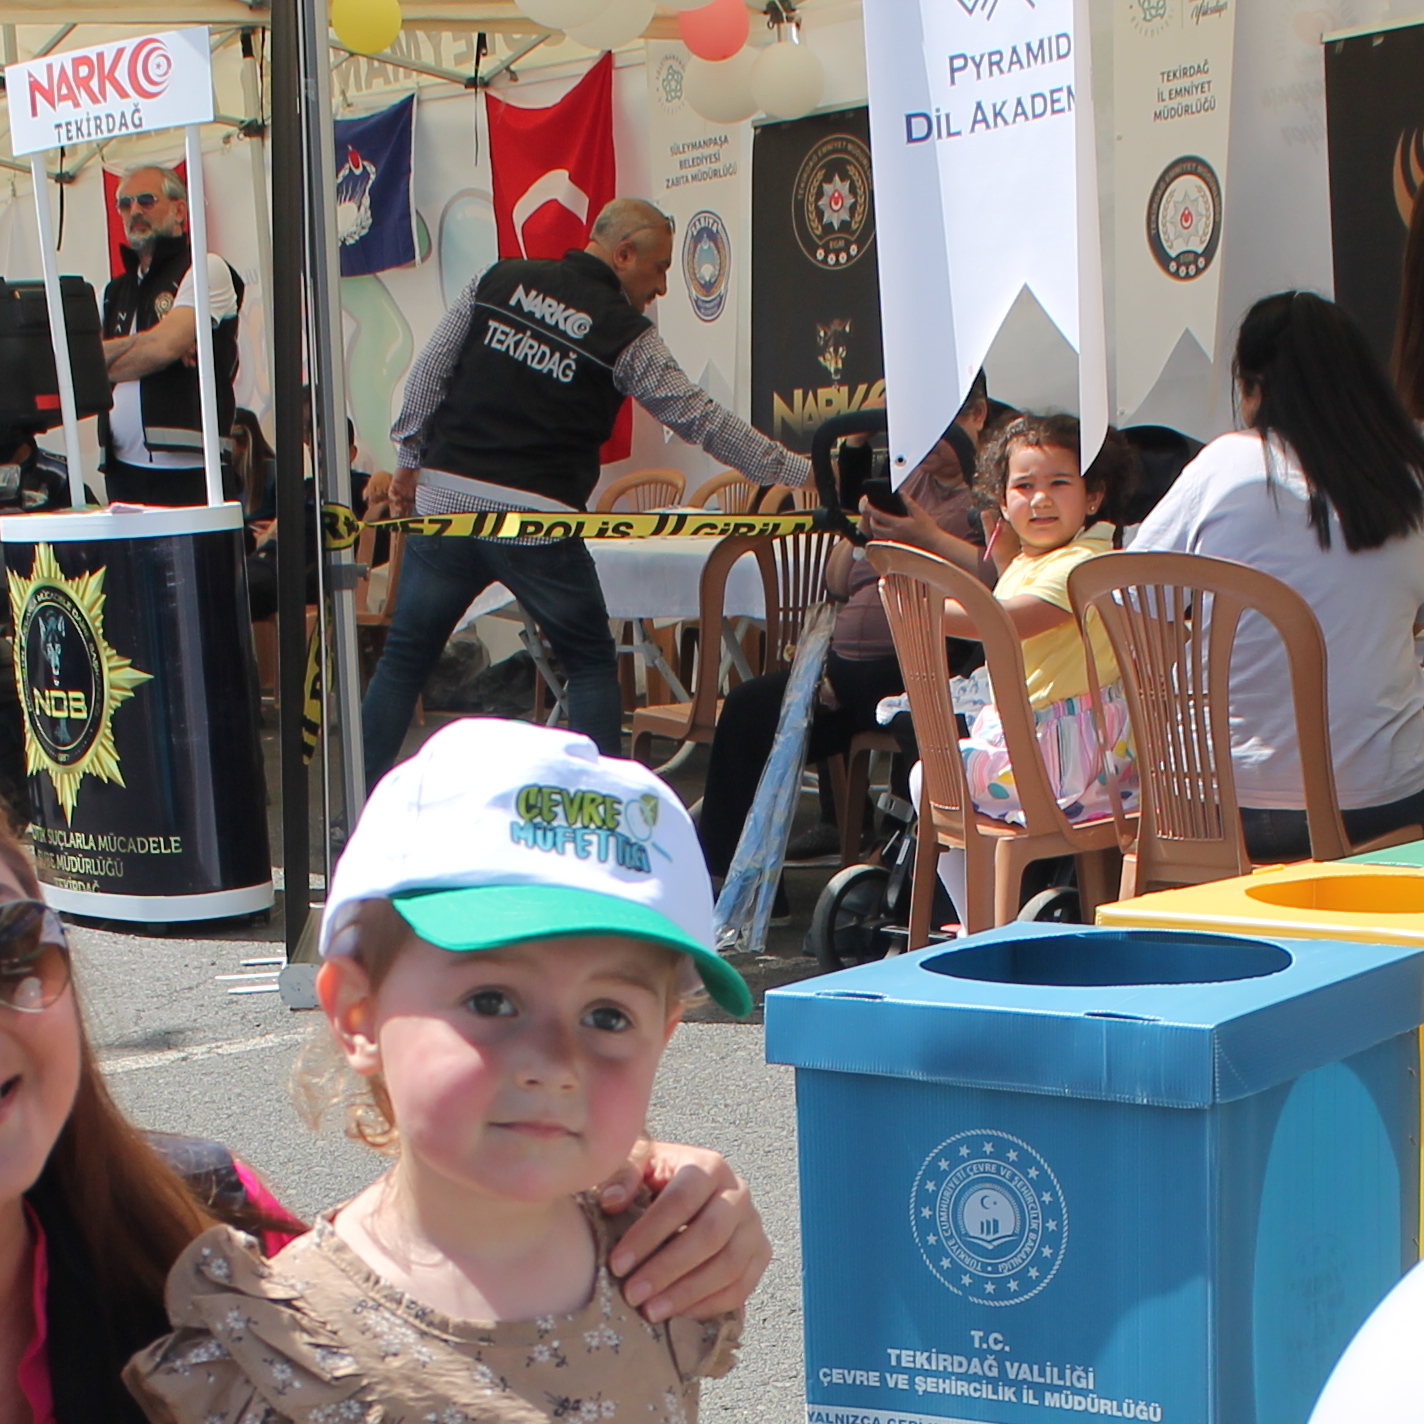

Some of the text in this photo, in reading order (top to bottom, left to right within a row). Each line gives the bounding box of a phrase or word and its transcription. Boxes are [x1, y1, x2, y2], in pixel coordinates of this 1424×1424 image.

[948, 31, 1072, 87] PYRAMID
[1160, 59, 1210, 84] TEKİRDAĞ
[1157, 80, 1213, 103] İL EMNİYET
[54, 103, 144, 143] TEKİRDAĞ
[1153, 98, 1217, 122] MÜDÜRLÜĞÜ
[904, 107, 963, 144] DİL
[669, 135, 730, 157] SÜLEYMANPAŞA
[679, 151, 721, 171] BELEDİYESİ
[665, 162, 738, 190] ZABITA MÜDÜRLÜĞÜ
[483, 319, 578, 383] TEKİRDAĞ
[33, 687, 88, 719] NDB
[97, 831, 184, 855] MÜCADELE
[56, 852, 124, 878] MÜDÜRLÜĞÜ
[966, 1162, 997, 1176] ÇEVRE
[1000, 1166, 1012, 1180] VE
[970, 1329, 1011, 1352] T.C.
[887, 1347, 1095, 1390] TEKİRDAĞ VALİLİĞİ
[818, 1367, 1163, 1424] ÇEVRE VE ŞEHİRCİLİK İL MÜDÜRLÜĞÜ
